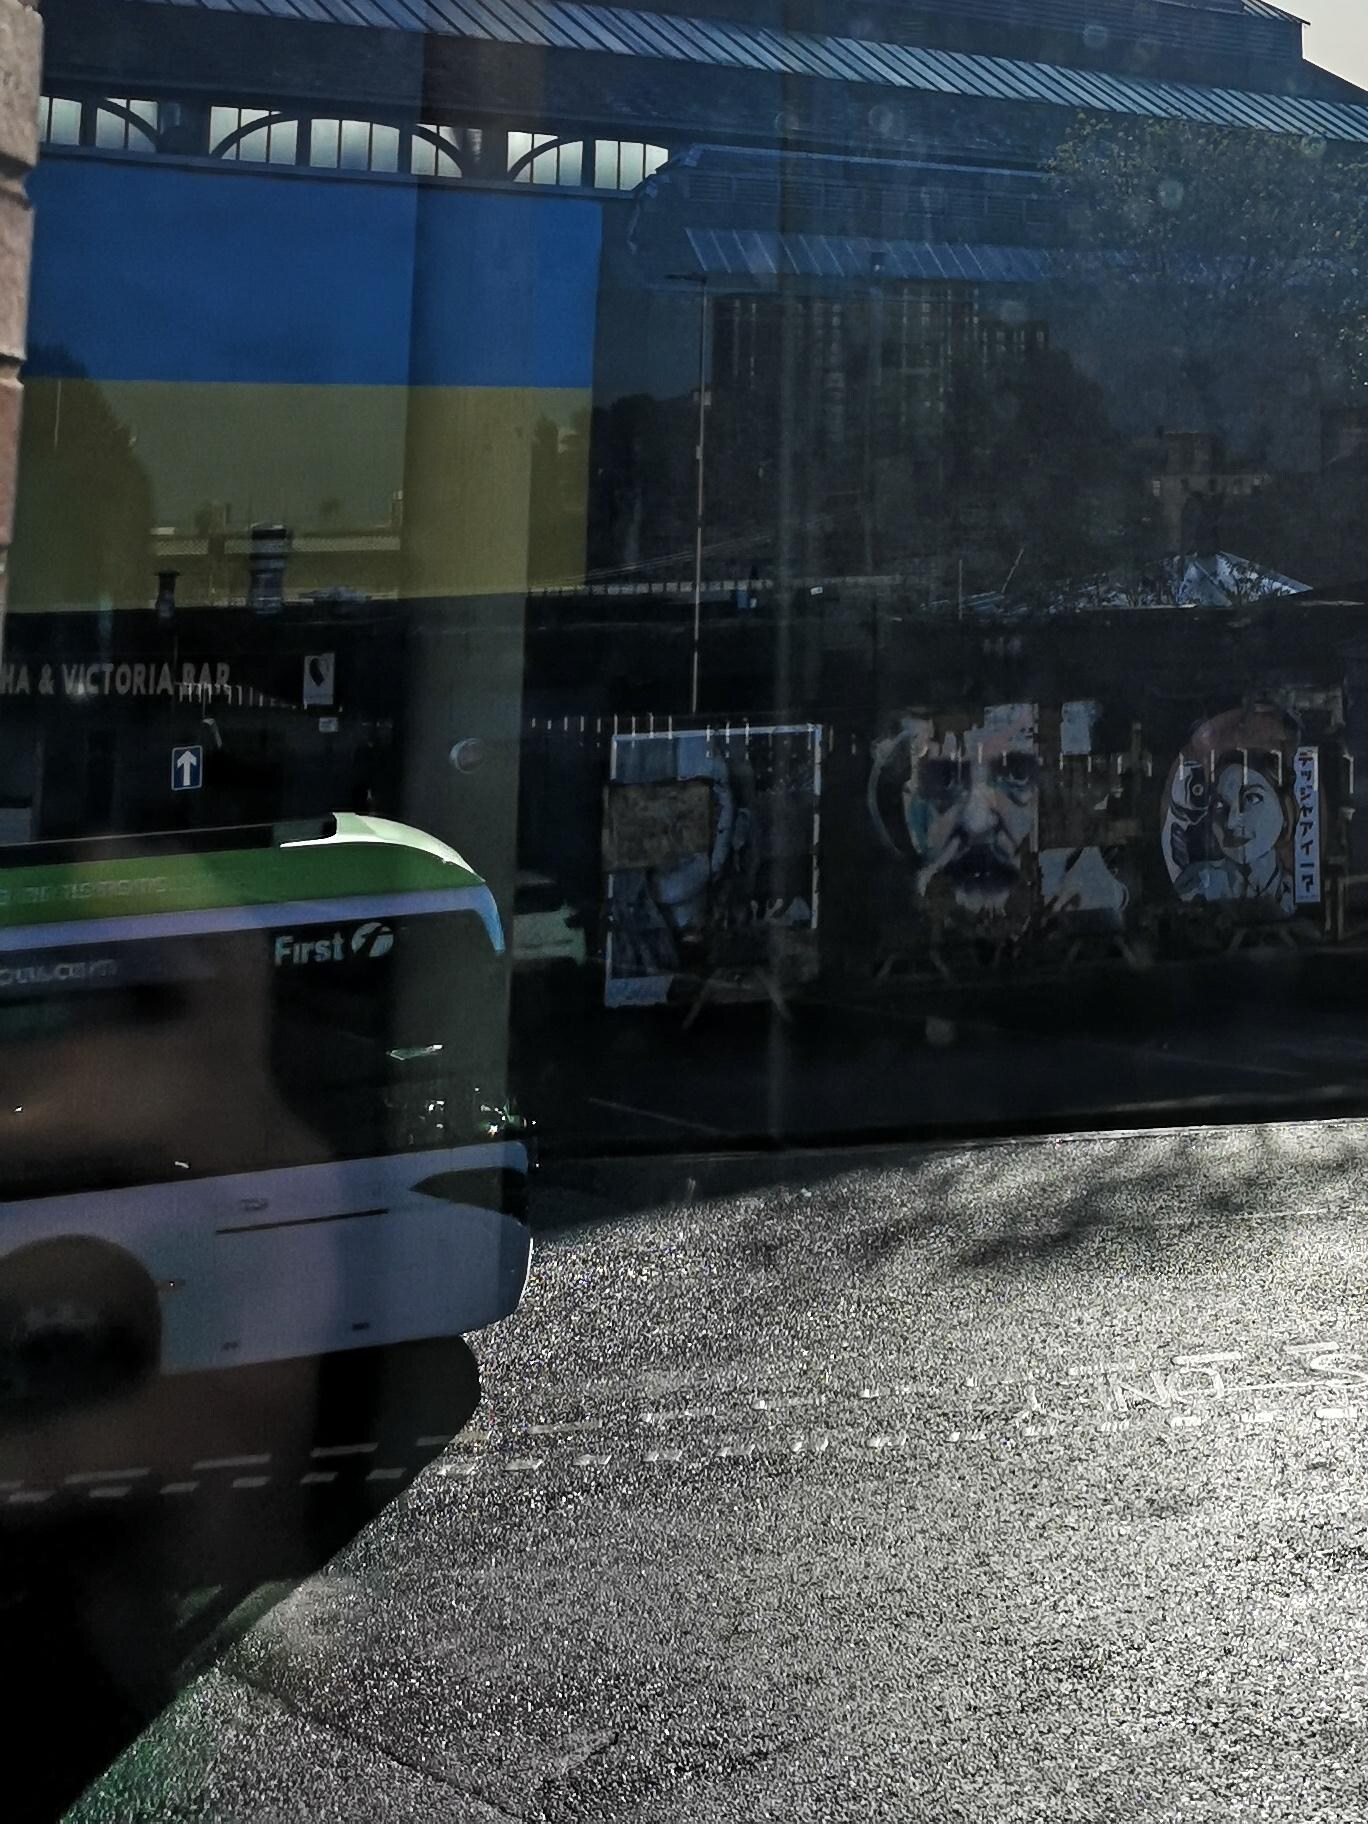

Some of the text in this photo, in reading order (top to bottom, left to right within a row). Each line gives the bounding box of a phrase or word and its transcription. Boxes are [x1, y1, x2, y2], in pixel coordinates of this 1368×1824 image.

[39, 663, 54, 695] &
[62, 662, 175, 696] VICTORIA
[182, 661, 231, 695] BAR
[274, 930, 344, 967] First
